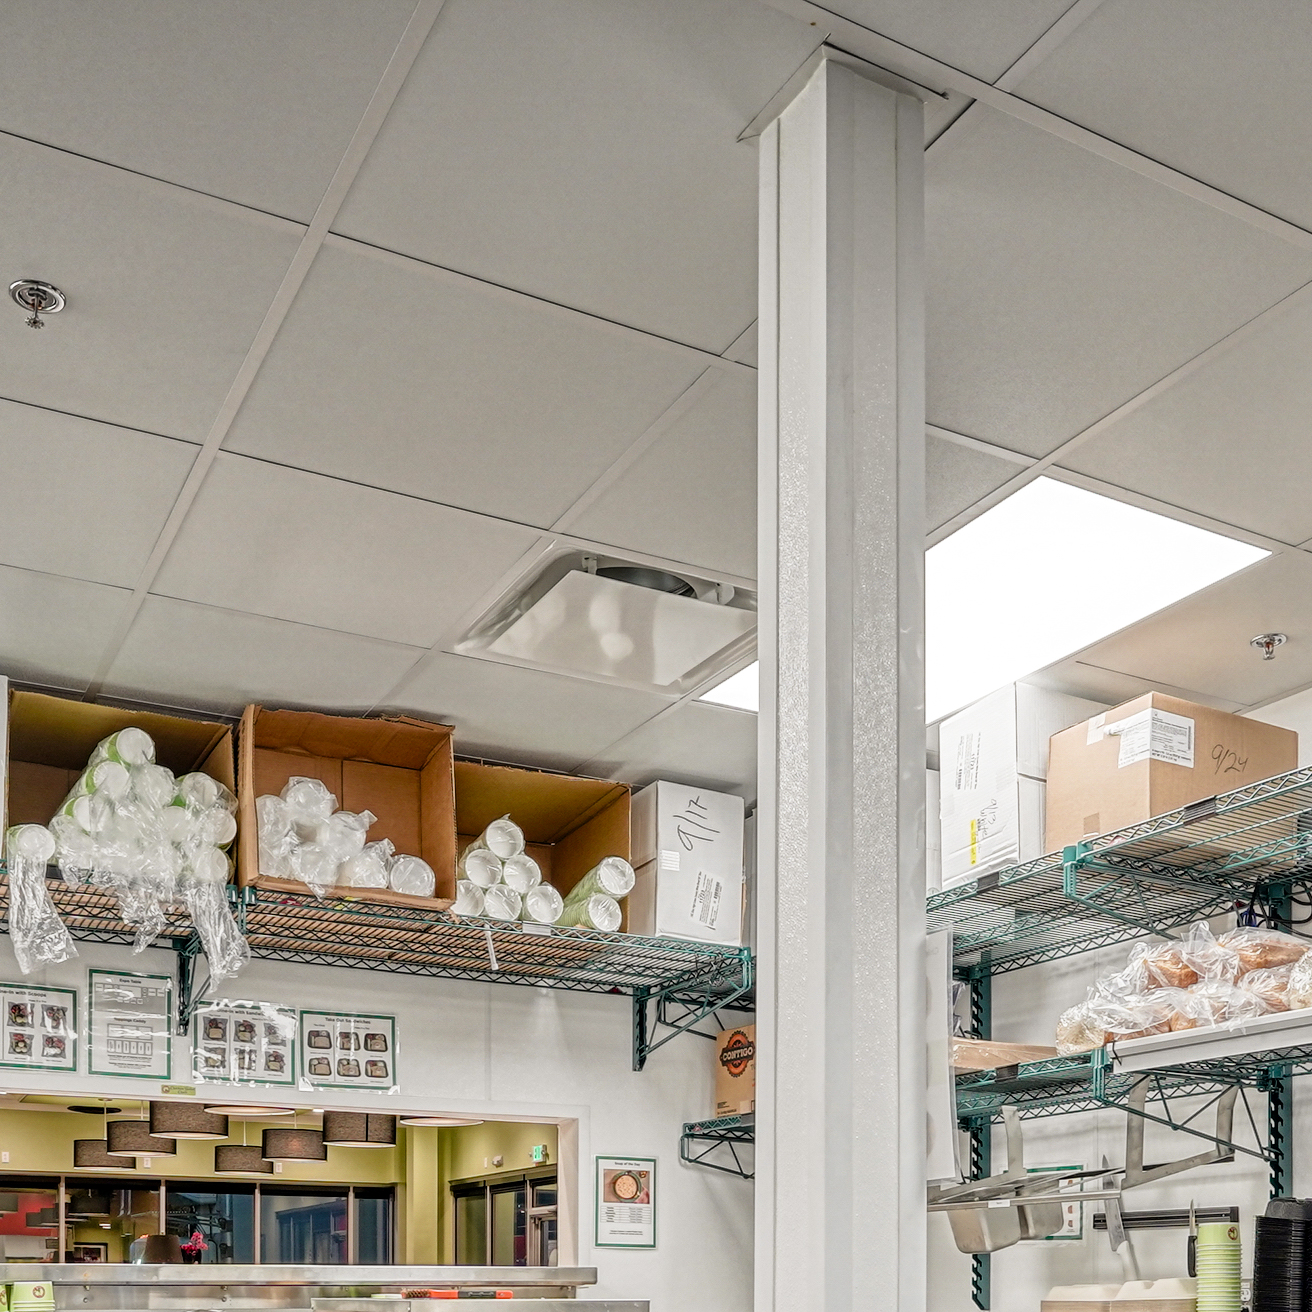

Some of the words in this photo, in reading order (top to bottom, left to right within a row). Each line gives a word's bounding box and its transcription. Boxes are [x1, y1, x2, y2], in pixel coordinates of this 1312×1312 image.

[1211, 744, 1248, 775] 9/24
[673, 796, 720, 851] 9/17
[722, 1046, 754, 1062] CONTIGO
